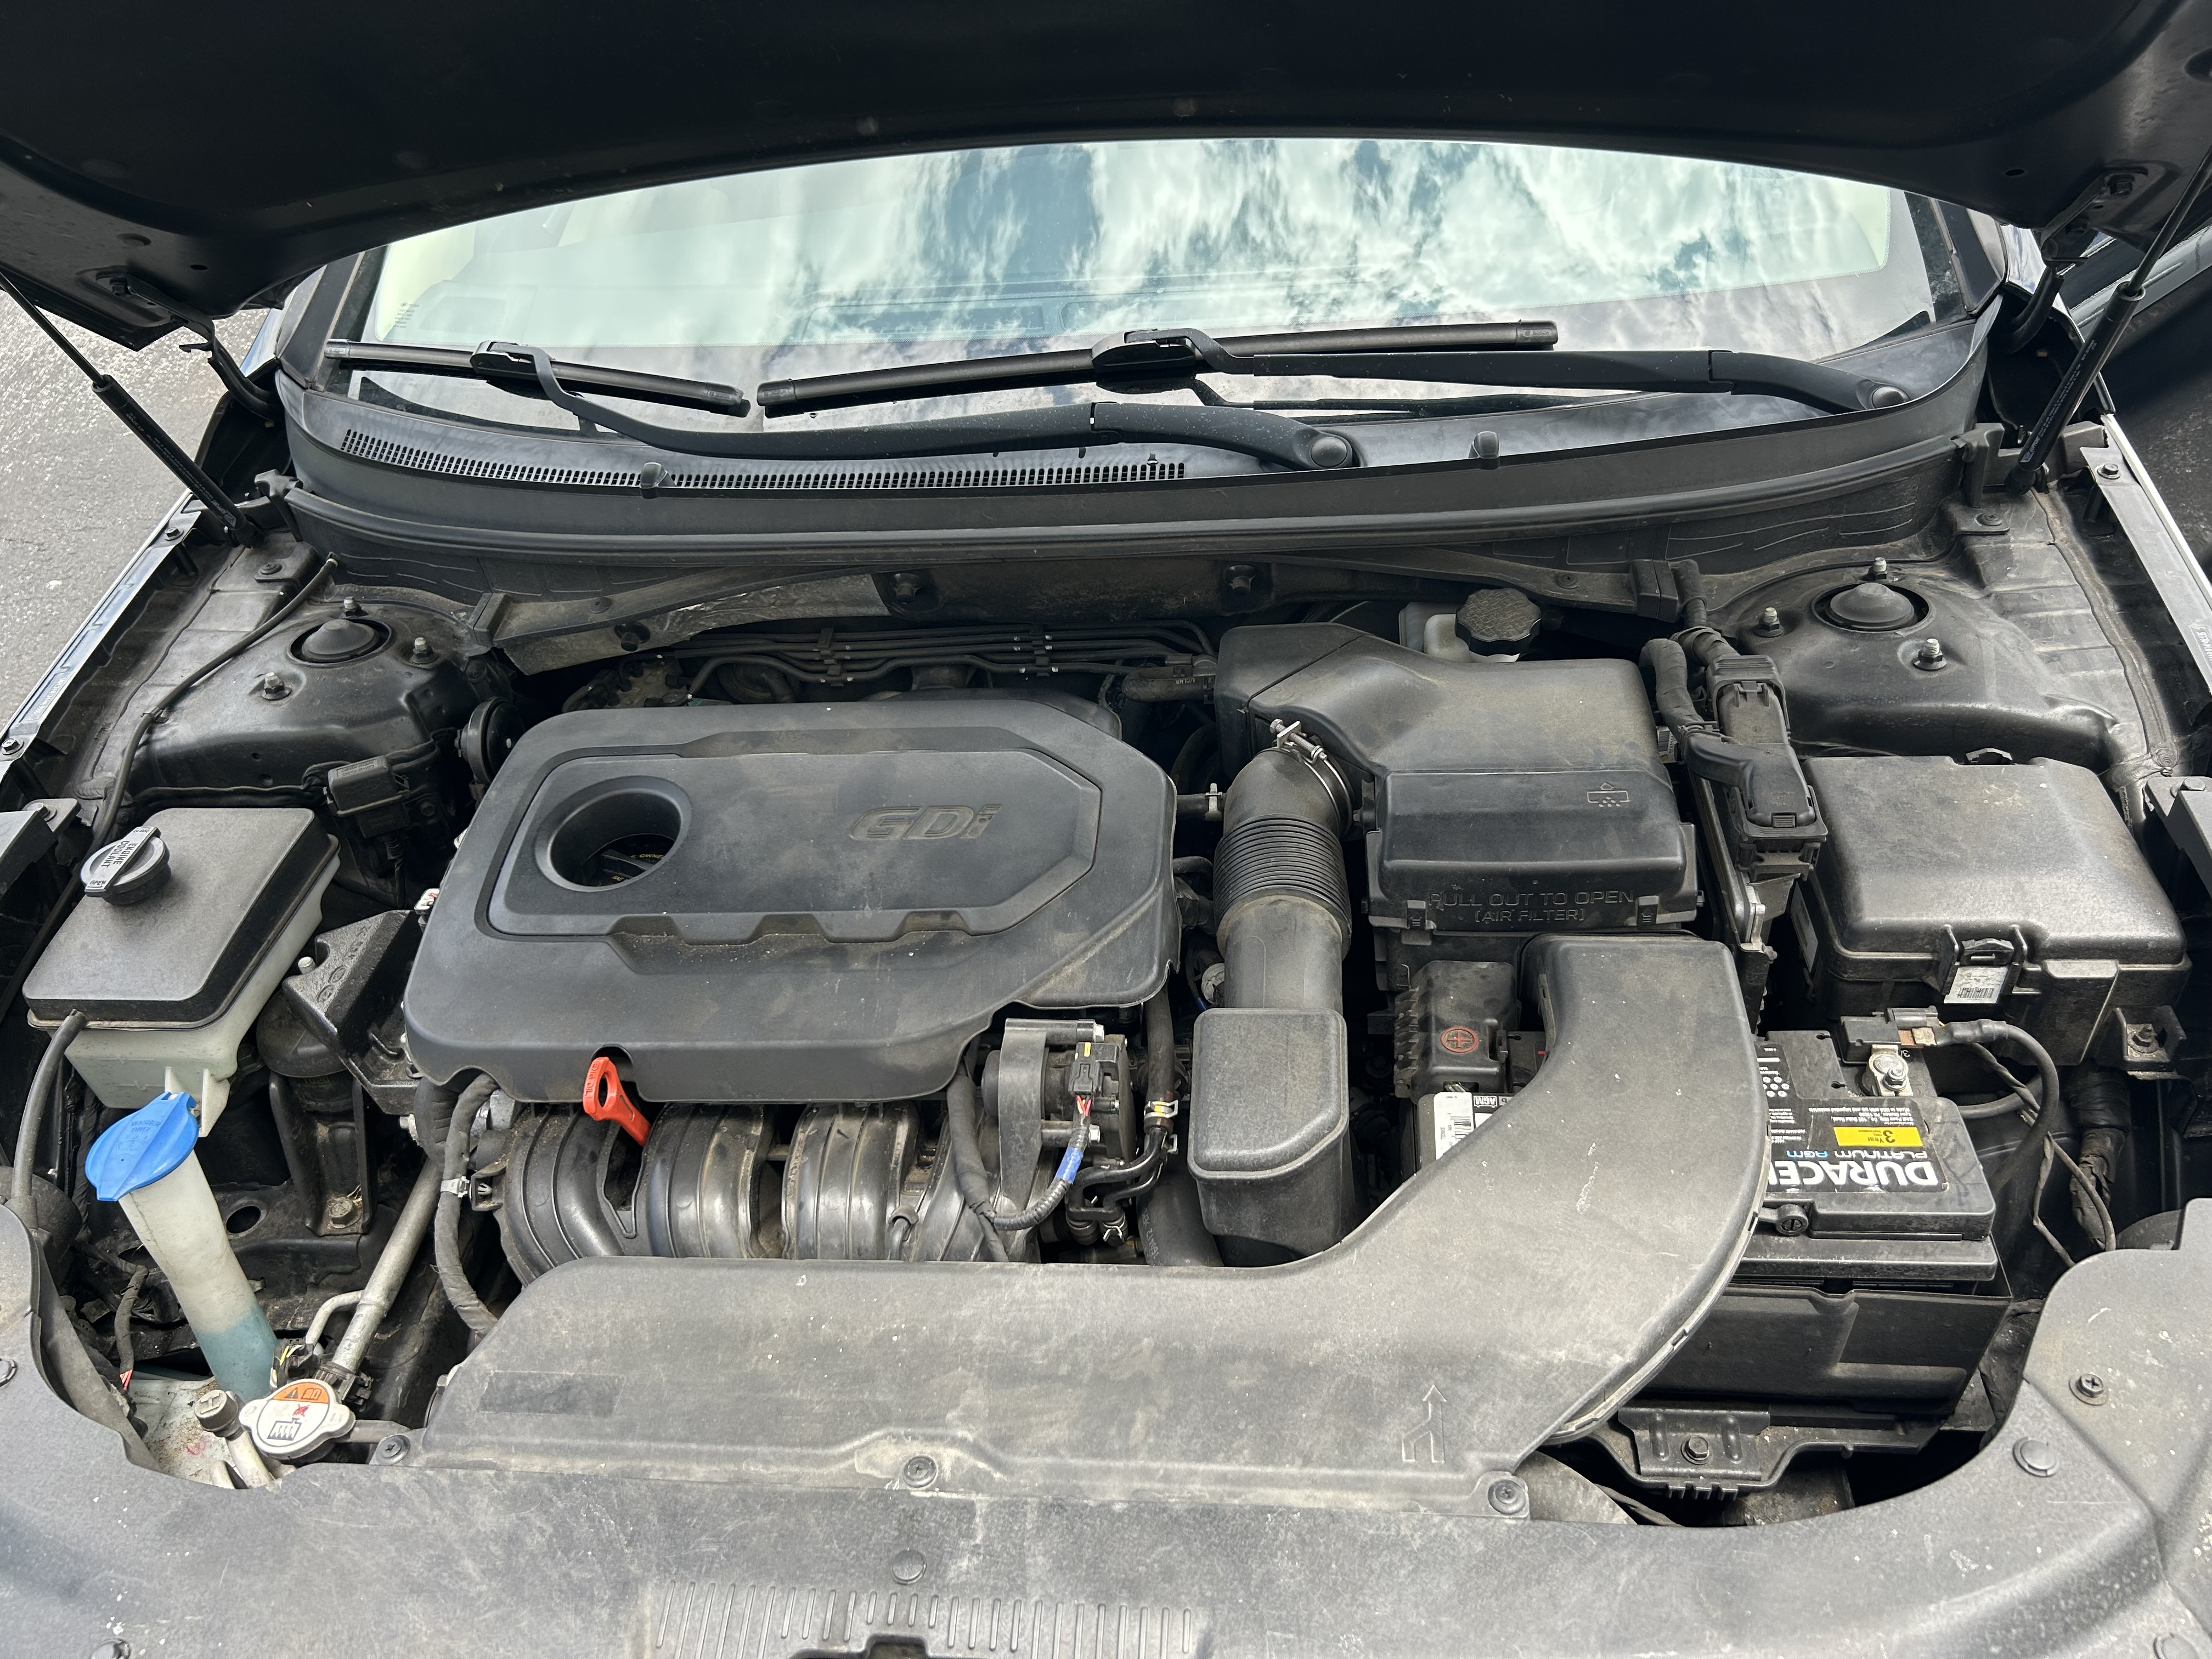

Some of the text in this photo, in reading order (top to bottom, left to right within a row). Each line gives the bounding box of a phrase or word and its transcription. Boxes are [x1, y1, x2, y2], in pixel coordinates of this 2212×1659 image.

[849, 804, 1002, 841] GDi
[100, 840, 130, 868] COOLANT
[112, 843, 138, 865] ENGINE
[1429, 889, 1634, 907] PULL OUT TO OPEN
[1475, 908, 1585, 923] (AIR FILTER)
[1475, 1096, 1496, 1105] AGM
[1882, 1130, 1896, 1143] 3
[1786, 1150, 1928, 1159] PLATINUM AGM
[1768, 1161, 1939, 1186] DURACE
